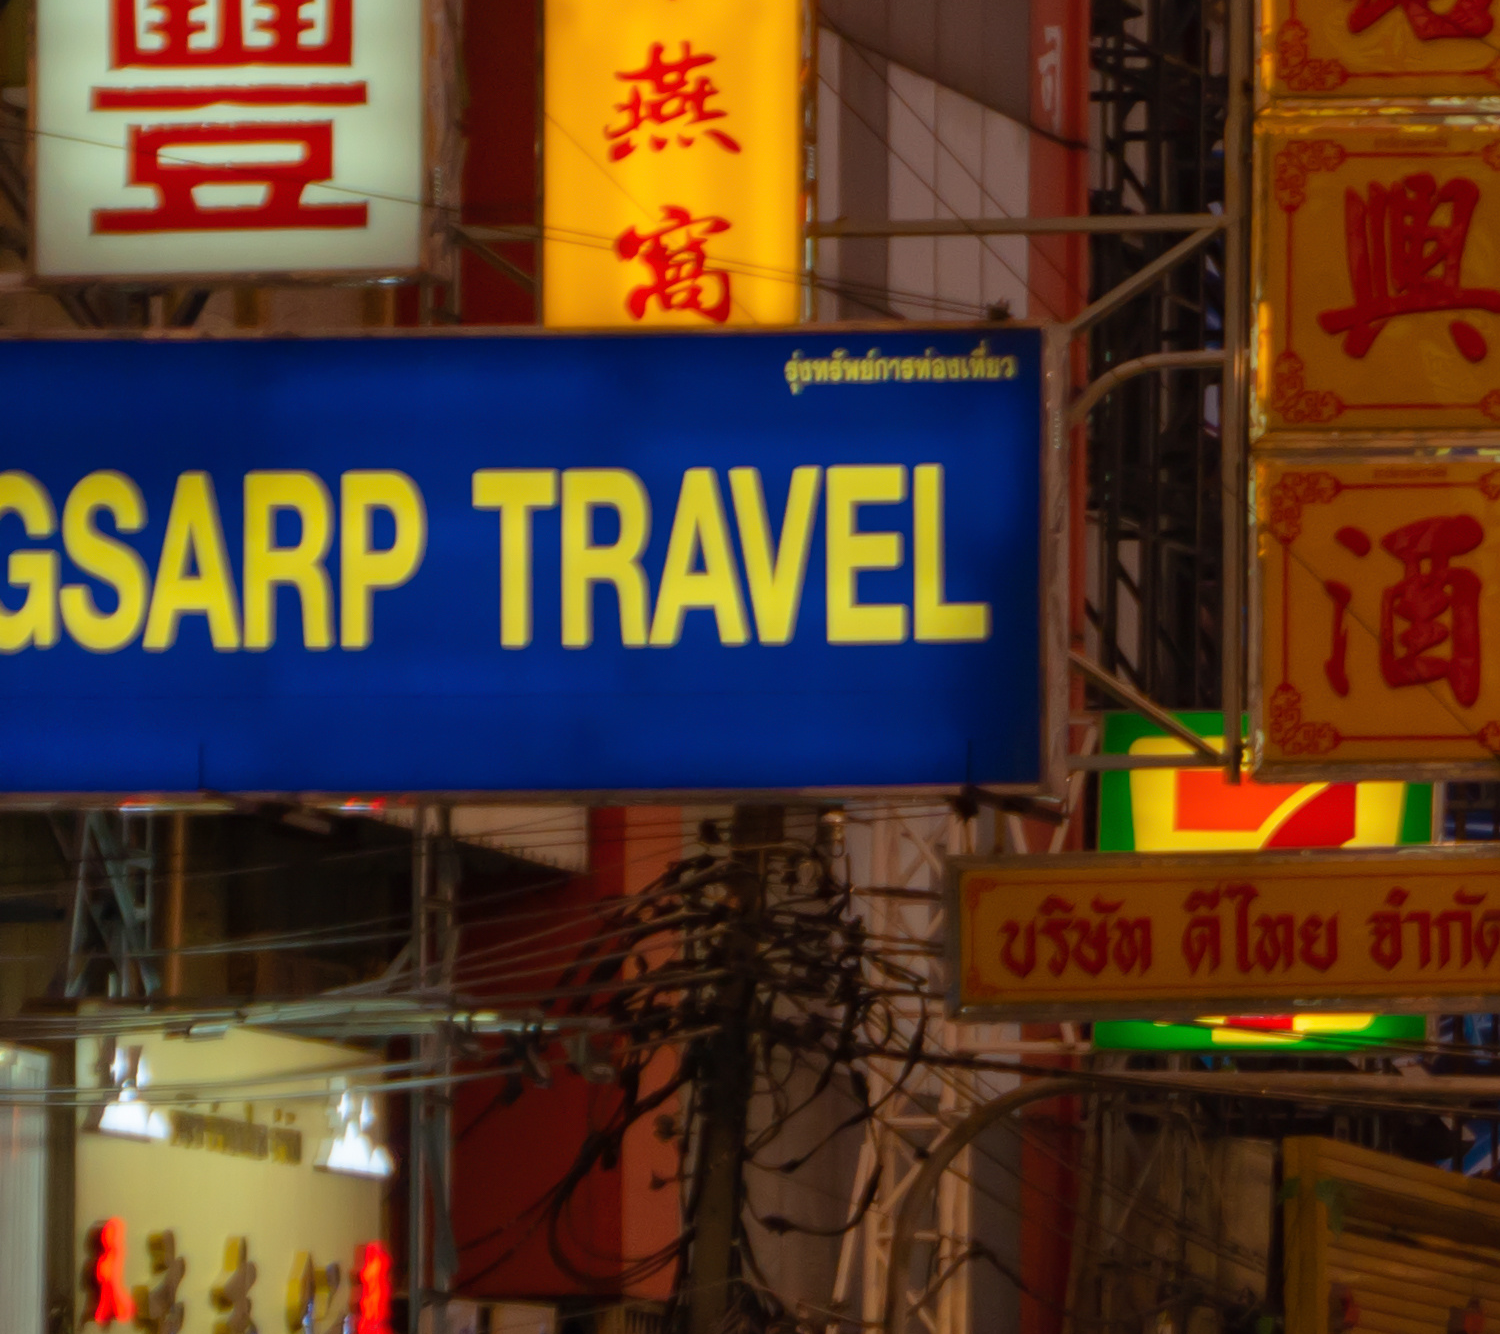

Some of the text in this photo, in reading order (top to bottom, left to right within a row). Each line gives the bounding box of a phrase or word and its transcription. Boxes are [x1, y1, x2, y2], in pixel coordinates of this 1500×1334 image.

[470, 463, 992, 649] TRAVEL
[1000, 897, 1153, 977] บริษัท
